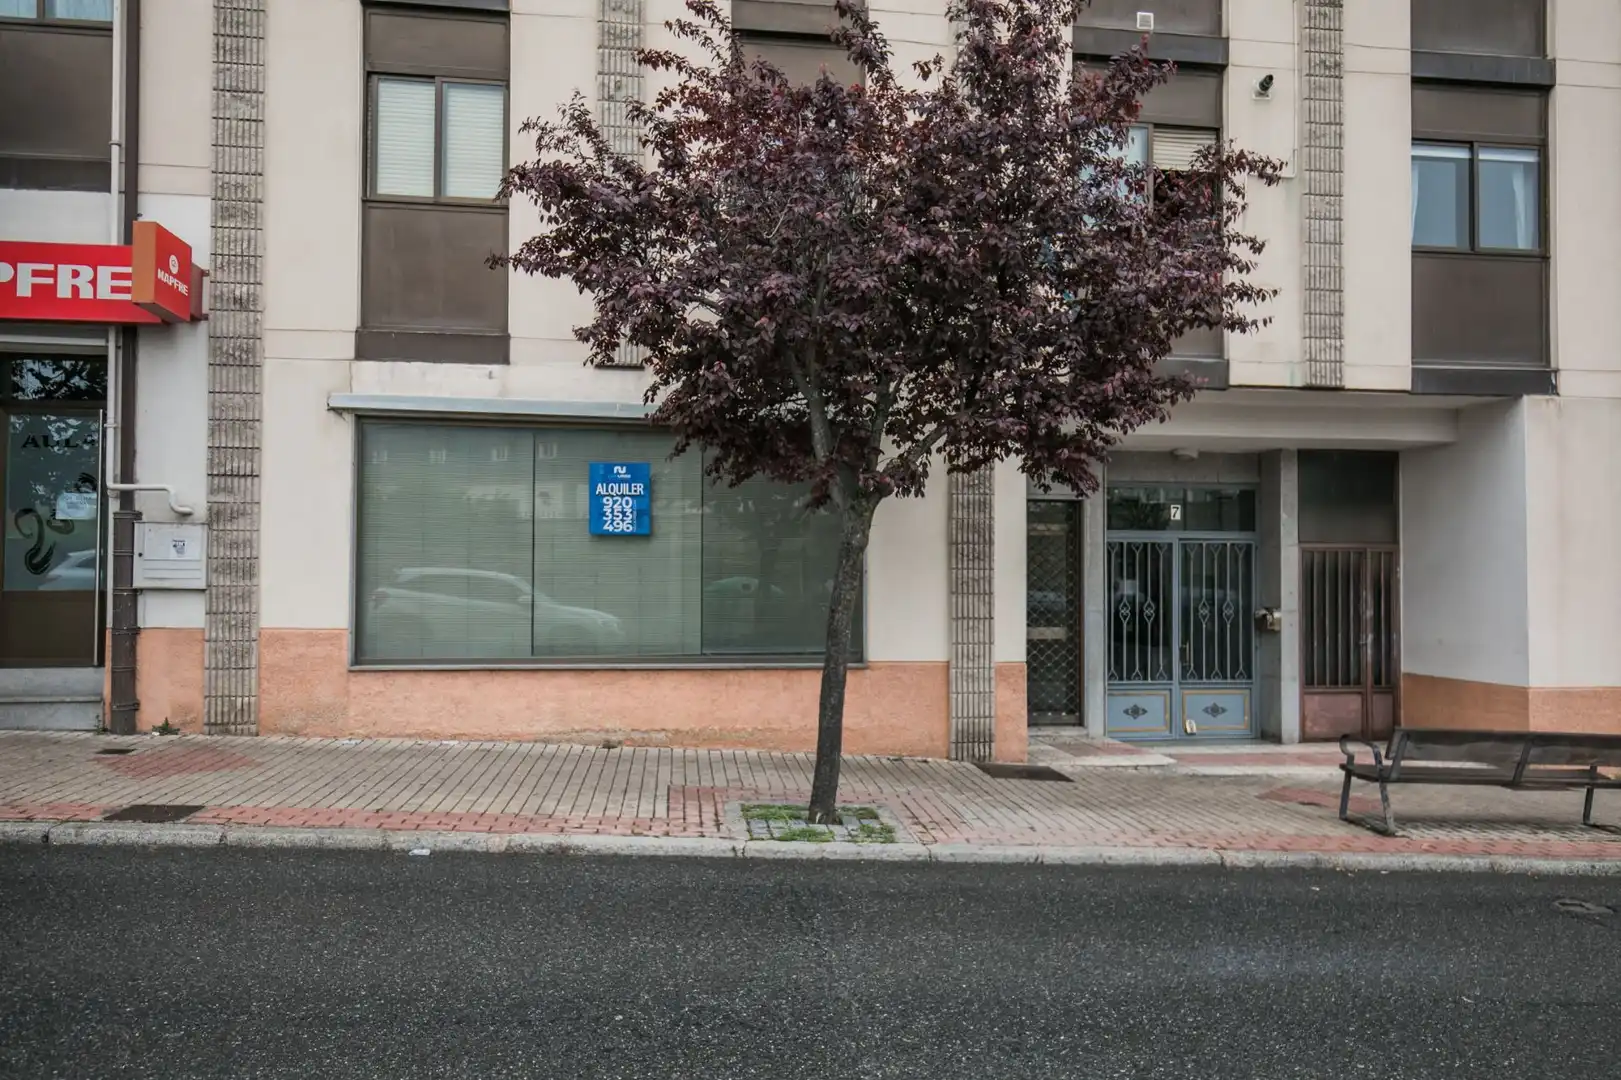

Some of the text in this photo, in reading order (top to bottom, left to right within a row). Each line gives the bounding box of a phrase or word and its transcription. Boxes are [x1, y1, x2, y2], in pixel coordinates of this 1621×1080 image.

[157, 267, 189, 297] MAPFRE
[596, 483, 644, 496] ALQUILER
[602, 496, 632, 509] 920
[602, 508, 633, 520] 353
[1172, 506, 1180, 519] 7
[602, 520, 633, 533] 496
